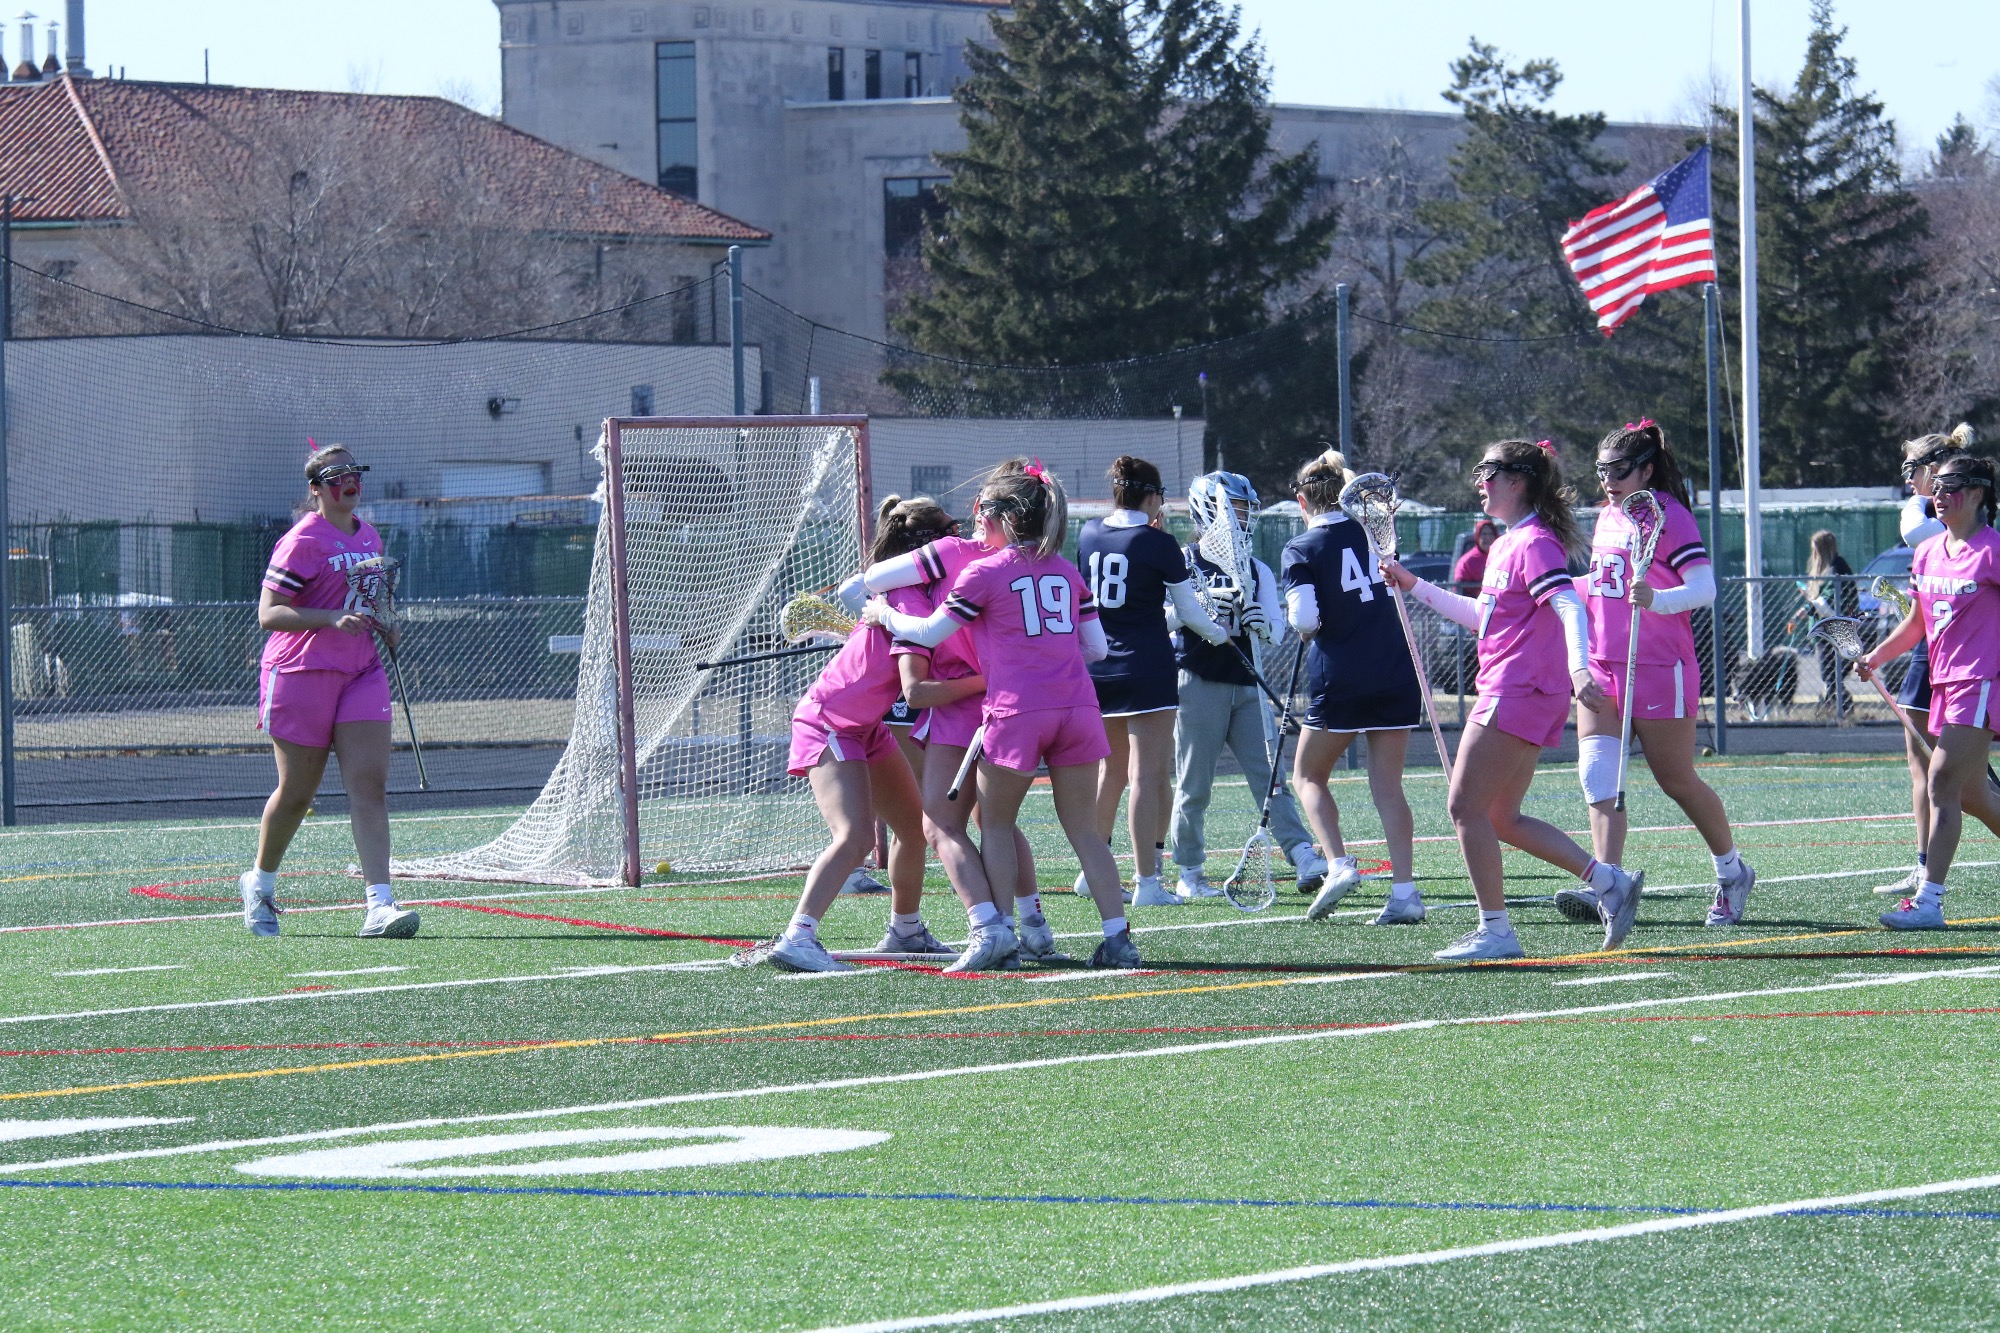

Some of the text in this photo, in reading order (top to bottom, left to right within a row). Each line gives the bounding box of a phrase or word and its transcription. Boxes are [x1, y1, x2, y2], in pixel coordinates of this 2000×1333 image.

[1089, 551, 1129, 609] 18
[1588, 552, 1626, 599] 23
[1009, 574, 1075, 637] 19
[1932, 599, 1954, 643] 2
